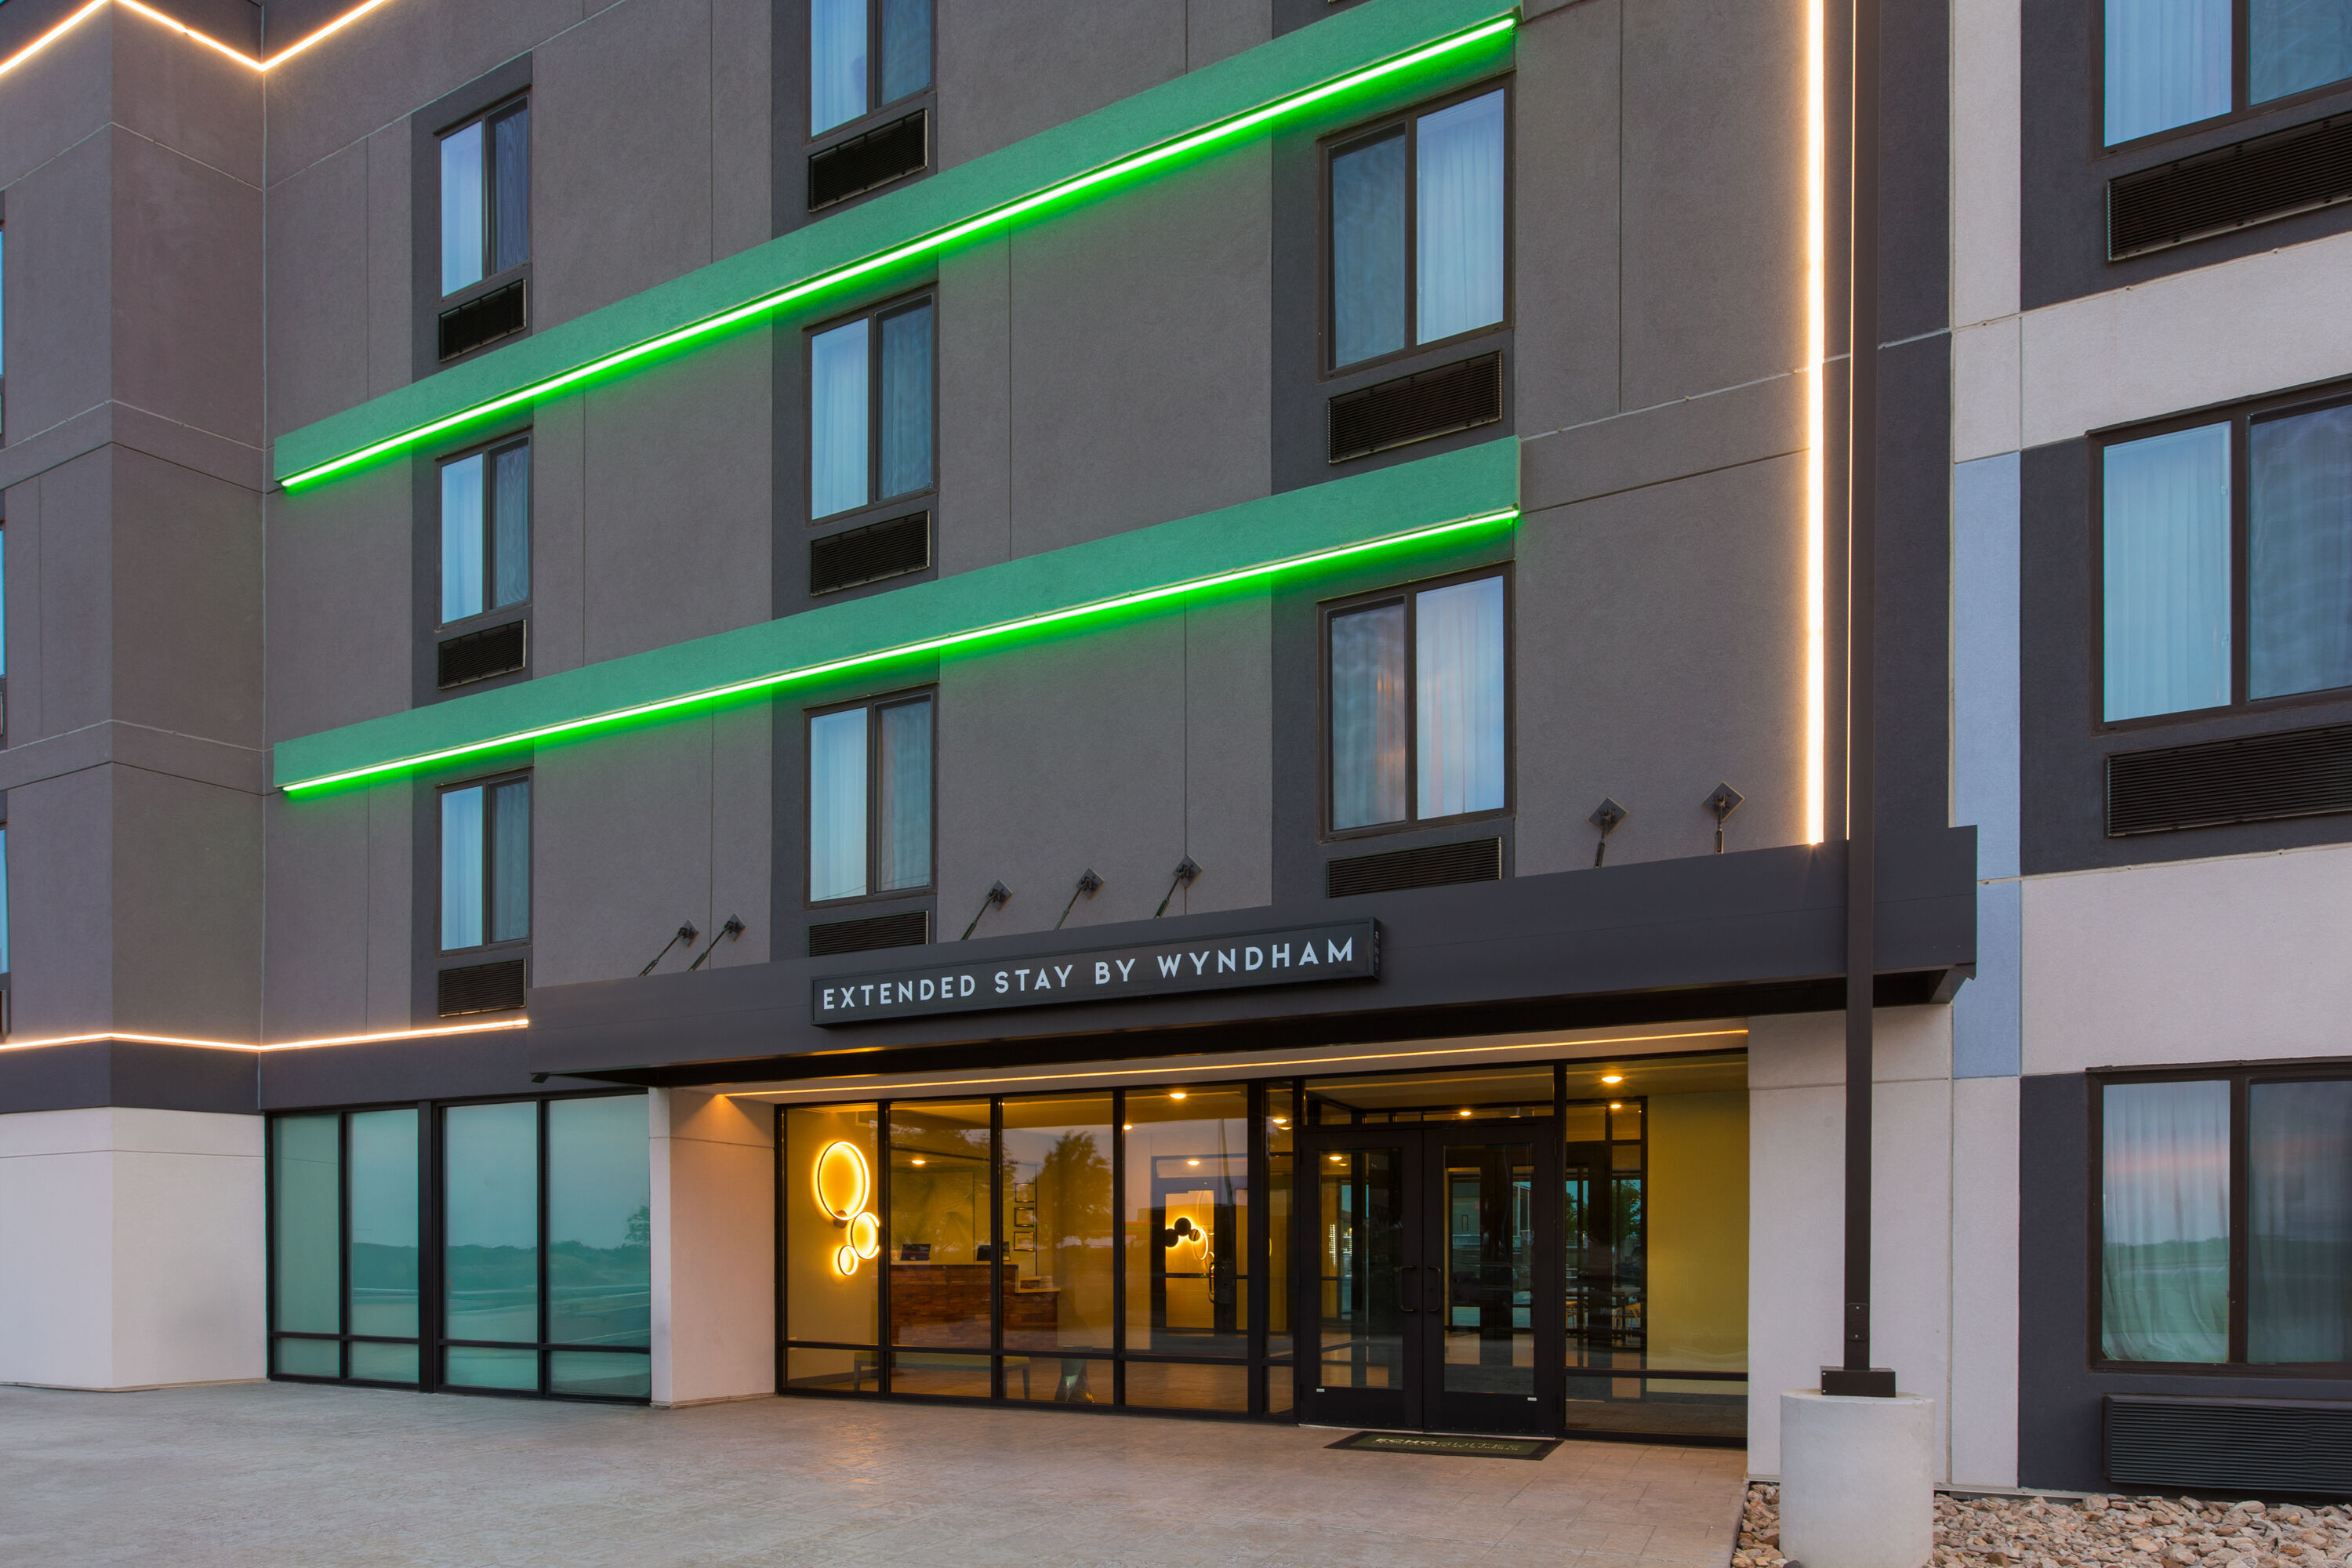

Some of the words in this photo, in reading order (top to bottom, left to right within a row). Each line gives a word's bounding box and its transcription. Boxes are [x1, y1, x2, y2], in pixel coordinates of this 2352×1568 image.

[823, 975, 975, 1010] EXTENDED
[994, 964, 1073, 993] STAY
[1095, 958, 1136, 985] BY
[1156, 937, 1352, 978] WYNDHAM
